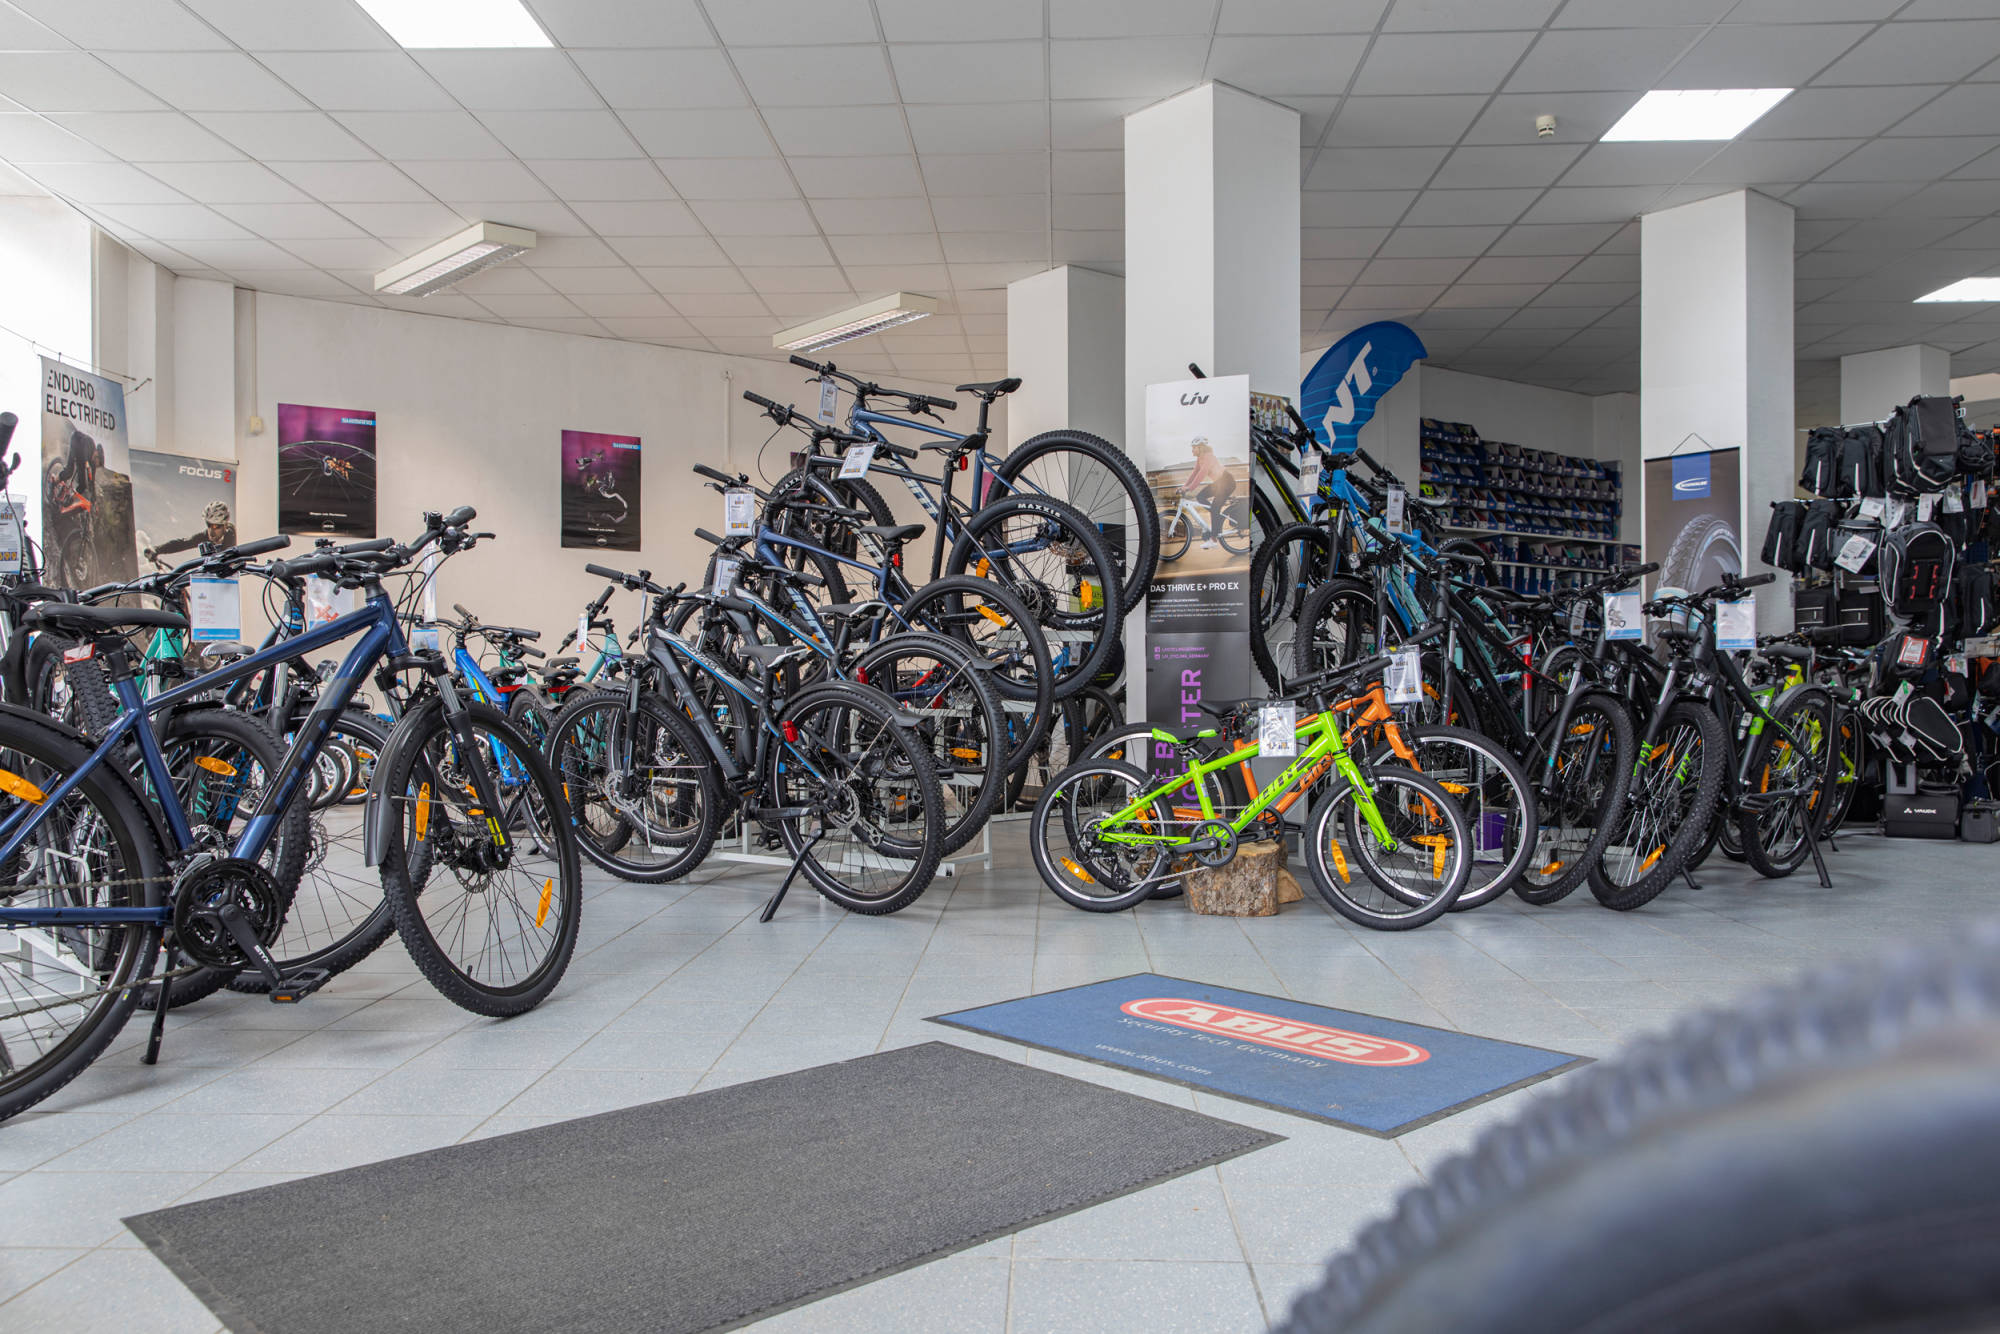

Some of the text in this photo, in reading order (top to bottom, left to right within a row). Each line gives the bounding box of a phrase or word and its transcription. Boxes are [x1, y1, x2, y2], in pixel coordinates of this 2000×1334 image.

[47, 369, 96, 401] ENDURO
[1179, 391, 1210, 406] Liv
[46, 393, 116, 431] ELECTRIFIED
[178, 465, 223, 479] FOCUS
[1017, 503, 1061, 518] MAXXIS
[1150, 581, 1239, 593] DAS THRIVE E+ PRO EX
[1154, 1006, 1386, 1057] ABUS
[1117, 1018, 1189, 1037] Security
[1236, 1044, 1329, 1069] Germany
